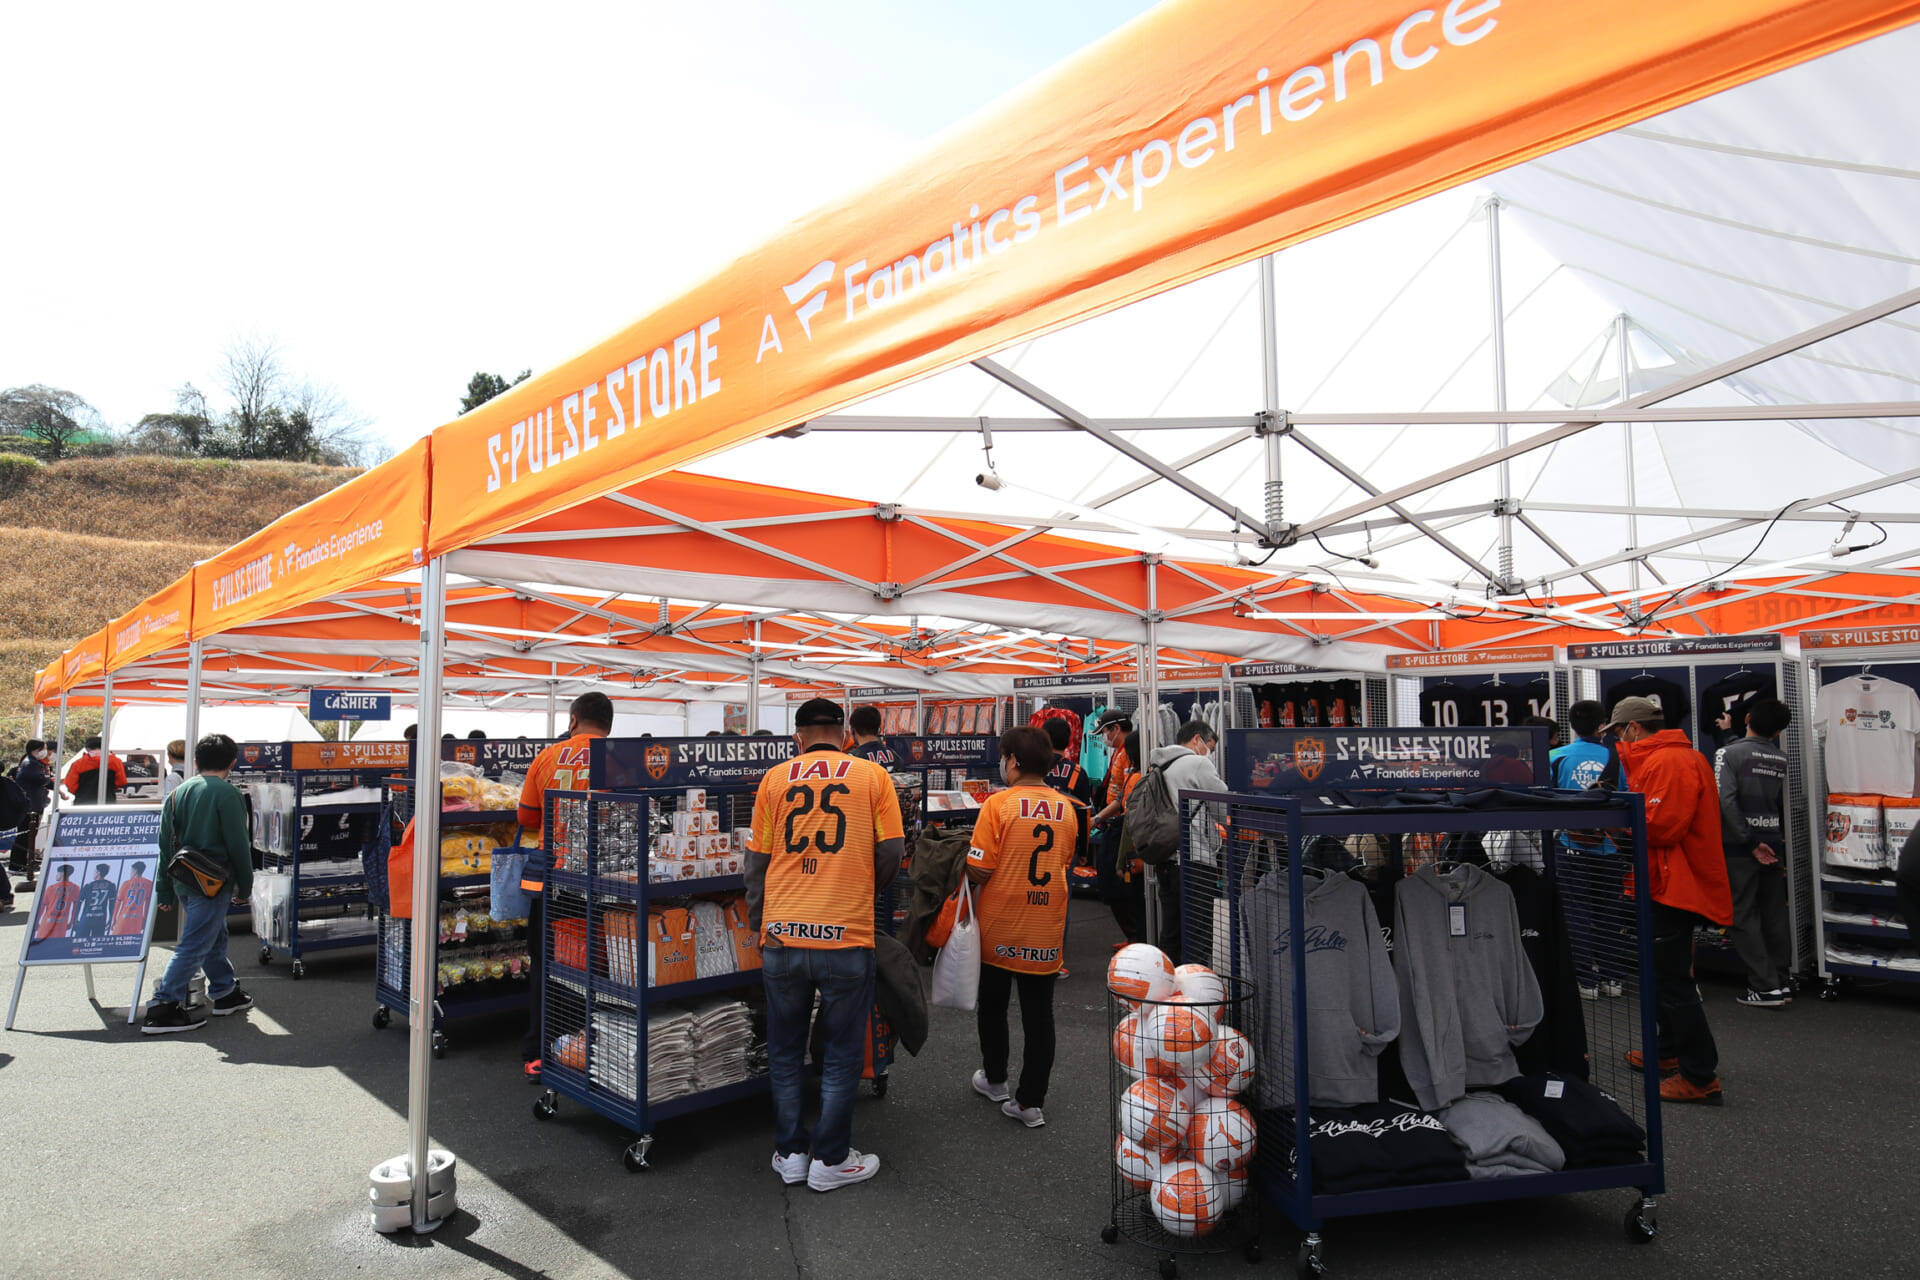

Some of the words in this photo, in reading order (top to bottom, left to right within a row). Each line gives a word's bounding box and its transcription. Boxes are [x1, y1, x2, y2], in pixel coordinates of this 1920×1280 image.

[487, 383, 599, 492] S-PULSE
[606, 316, 720, 440] STORE
[755, 314, 783, 363] A
[844, 196, 1041, 323] Fanatics
[1055, 0, 1500, 229] Experience
[212, 565, 245, 611] S-PULSE
[246, 553, 273, 597] STORE
[277, 564, 284, 579] A
[295, 539, 329, 571] Fanatics
[330, 519, 383, 560] Experience
[1832, 630, 1890, 645] S-PULSE
[1591, 644, 1637, 657] S-PULSE
[1638, 643, 1671, 653] STORE
[1696, 642, 1727, 650] Fanatics
[1728, 640, 1773, 649] Experience
[1405, 655, 1440, 666] S-PULSE
[1441, 653, 1469, 663] STORE
[1245, 665, 1273, 674] S-PULSE
[1275, 664, 1297, 673] STORE
[325, 696, 377, 710] CASHIER
[1432, 700, 1458, 727] 10
[1481, 699, 1509, 727] 13
[343, 744, 394, 757] S-PULSE
[484, 743, 541, 759] S-PULSE
[678, 743, 745, 763] S-PULSE
[750, 742, 794, 761] STORE
[927, 740, 960, 751] S-PULSE
[962, 740, 985, 750] STORE
[1336, 736, 1423, 760] S-PULSE
[1429, 736, 1491, 759] STORE
[867, 749, 894, 765] IAI
[688, 769, 696, 778] A
[709, 767, 742, 776] Fanatics
[787, 760, 853, 783] IAI
[1350, 770, 1359, 779] A
[1377, 767, 1420, 778] Fanatics
[1423, 767, 1480, 780] Experience
[785, 784, 850, 854] 25
[1019, 799, 1065, 822] IAI
[61, 817, 82, 825] 2021
[85, 816, 125, 825] J-LEAGUE
[61, 828, 86, 837] NAME
[96, 827, 130, 836] NUMBER
[1028, 824, 1054, 887] 2
[802, 858, 817, 875] HO
[90, 889, 109, 906] 37
[126, 889, 145, 906] 50
[1027, 891, 1049, 905] YUGO
[774, 922, 846, 941] S-TRUST
[1007, 946, 1060, 962] S-TRUST
